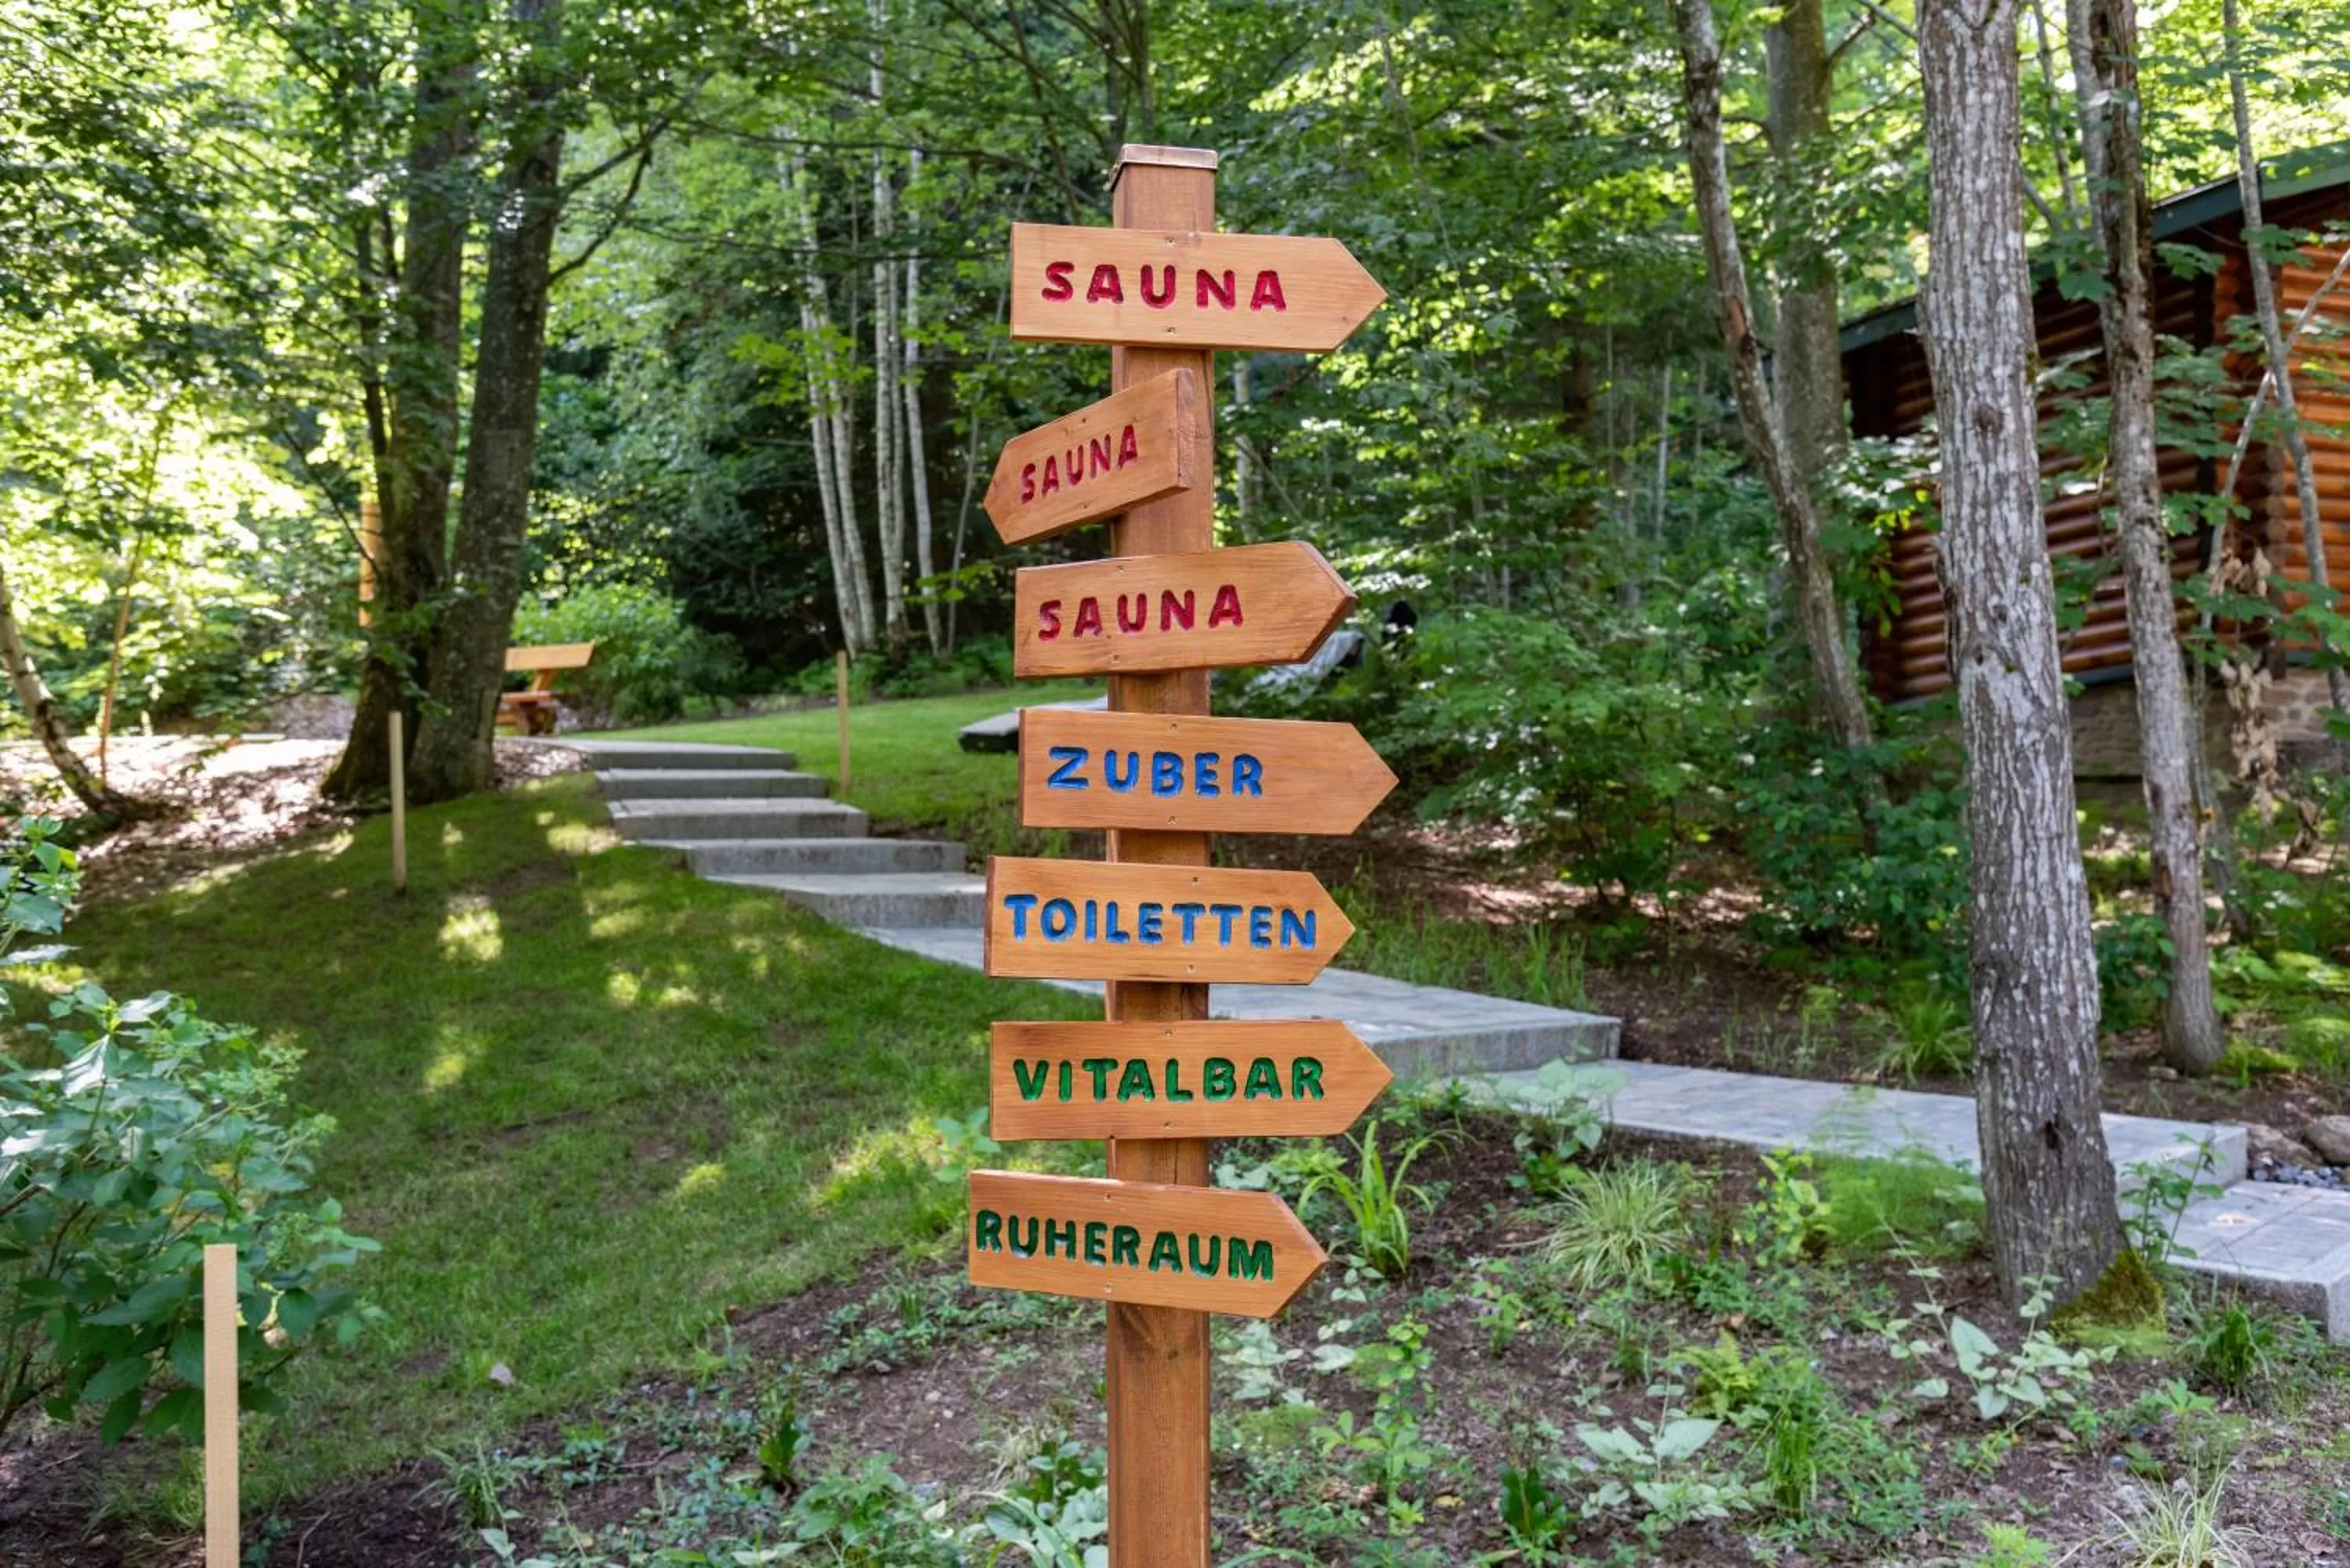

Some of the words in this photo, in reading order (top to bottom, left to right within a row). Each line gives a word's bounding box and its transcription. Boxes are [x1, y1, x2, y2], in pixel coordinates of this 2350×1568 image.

[1041, 260, 1287, 312] SAUNA
[1021, 424, 1139, 504] SAUNA
[1038, 584, 1244, 641] SAUNA
[1047, 746, 1264, 798] ZUBER
[1003, 894, 1317, 951] TOILETTEN
[1014, 1057, 1325, 1104] VITALBAR
[975, 1209, 1274, 1282] RUHERAUM
